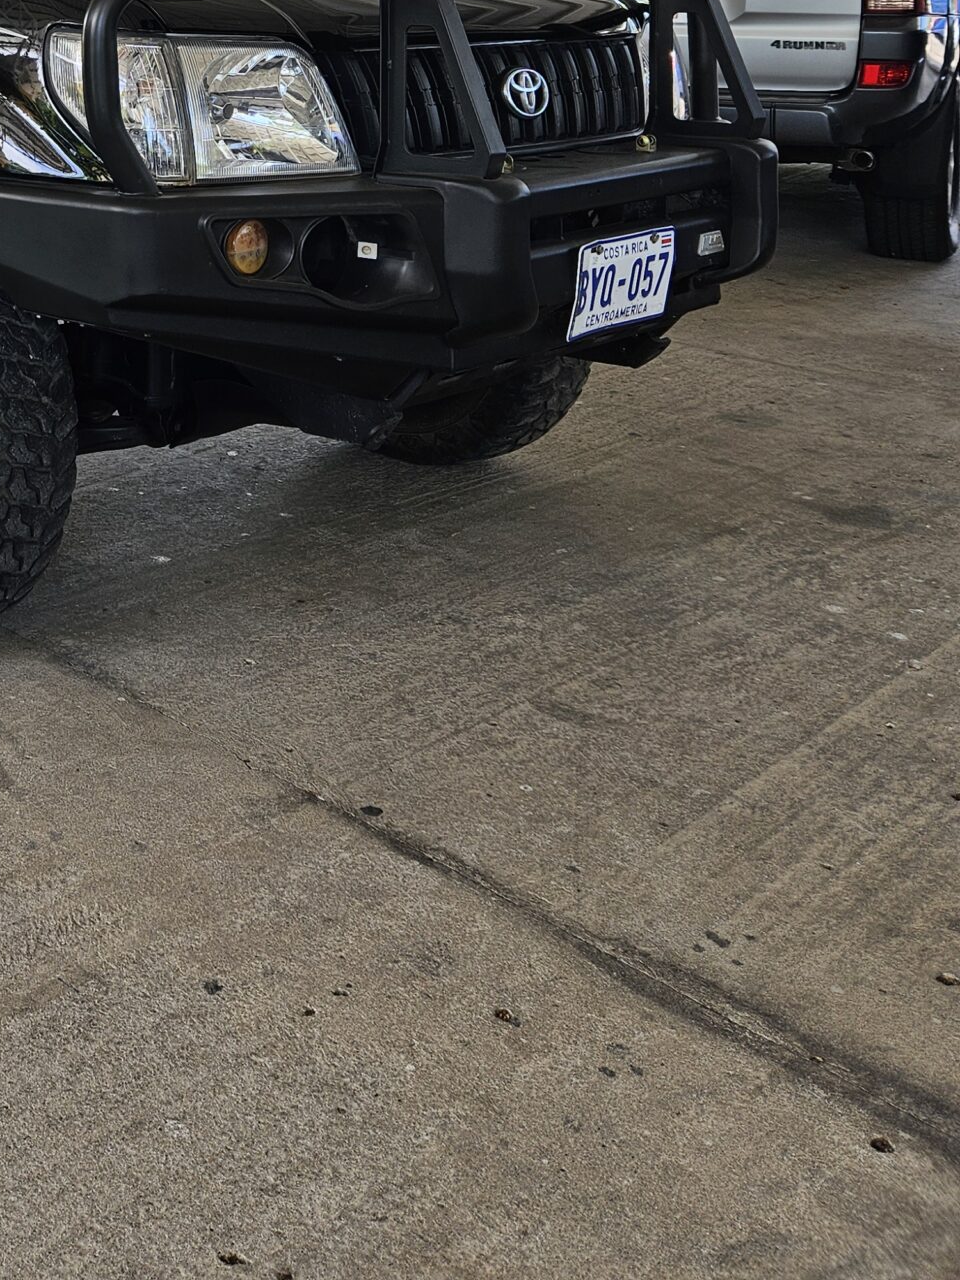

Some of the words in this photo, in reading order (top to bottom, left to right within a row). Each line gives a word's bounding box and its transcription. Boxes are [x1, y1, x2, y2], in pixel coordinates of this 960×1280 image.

[603, 244, 630, 260] COSTA
[631, 240, 649, 254] RICA
[585, 302, 648, 328] CENTROAMERICA
